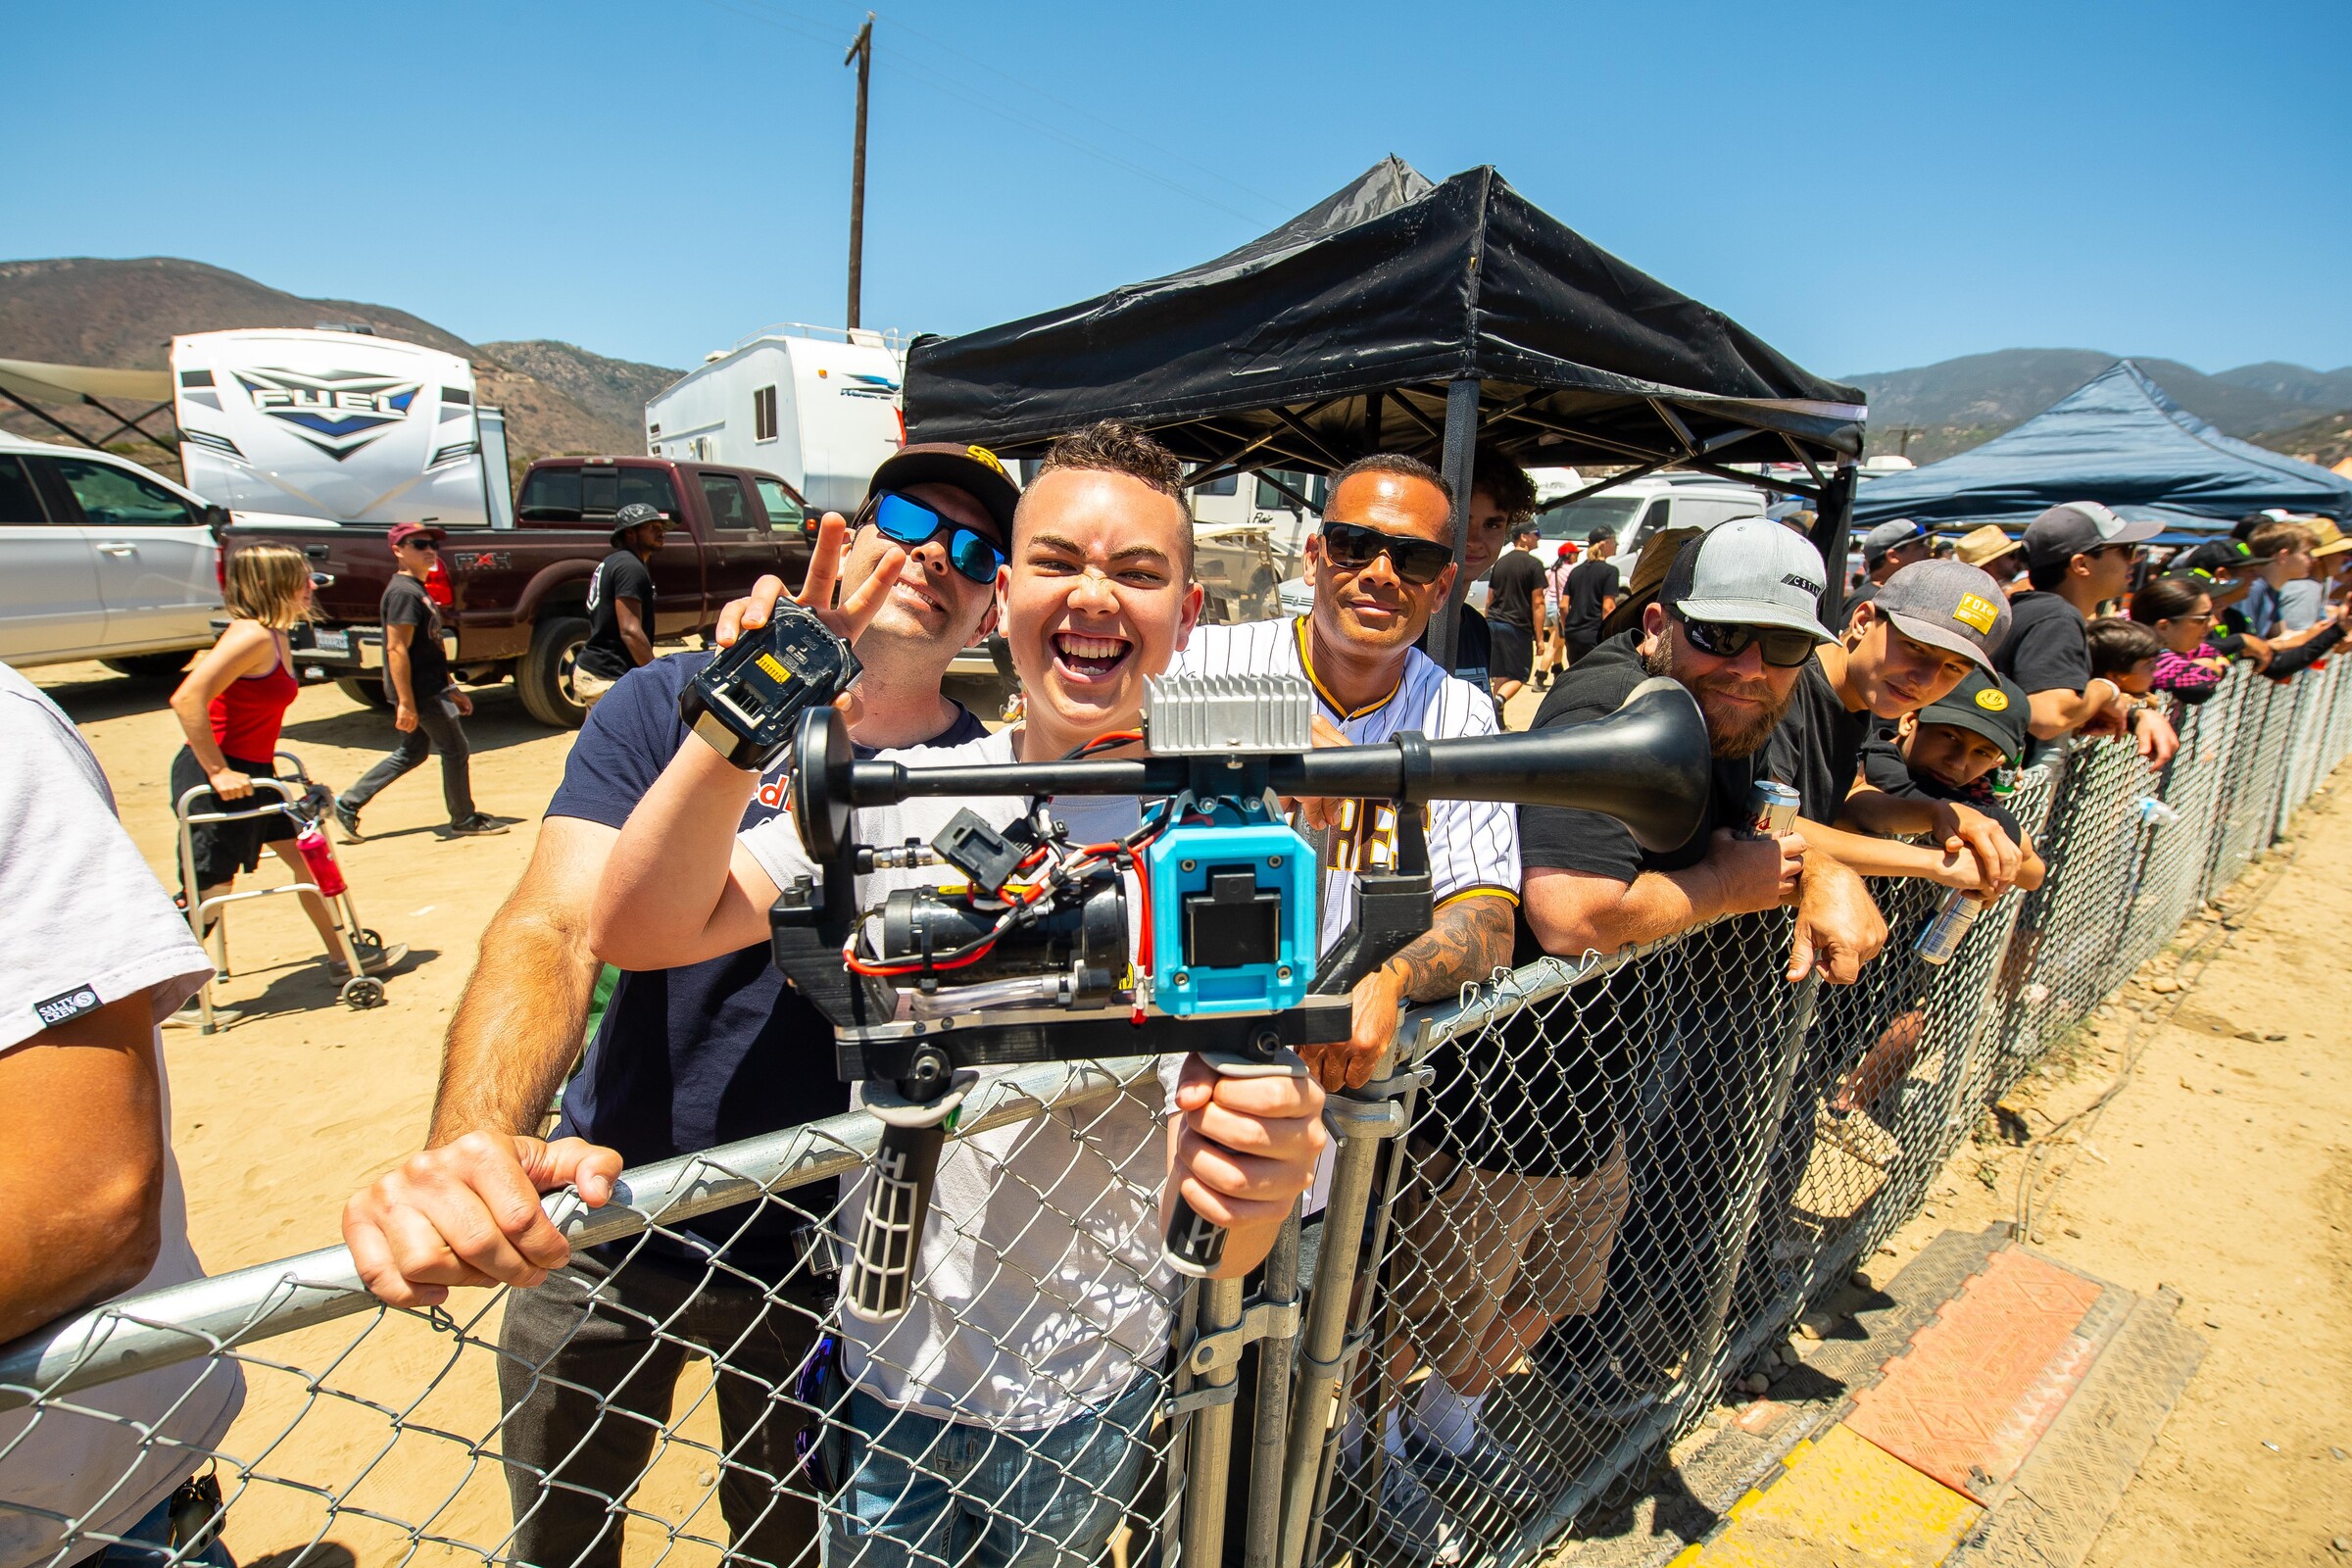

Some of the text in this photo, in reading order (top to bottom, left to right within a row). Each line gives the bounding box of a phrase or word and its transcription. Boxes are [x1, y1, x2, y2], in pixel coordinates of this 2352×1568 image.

[251, 388, 409, 416] FUEL
[1251, 512, 1274, 524] Flair
[1963, 595, 1989, 614] FOX
[38, 996, 74, 1016] SALTY
[43, 1006, 78, 1023] CREW
